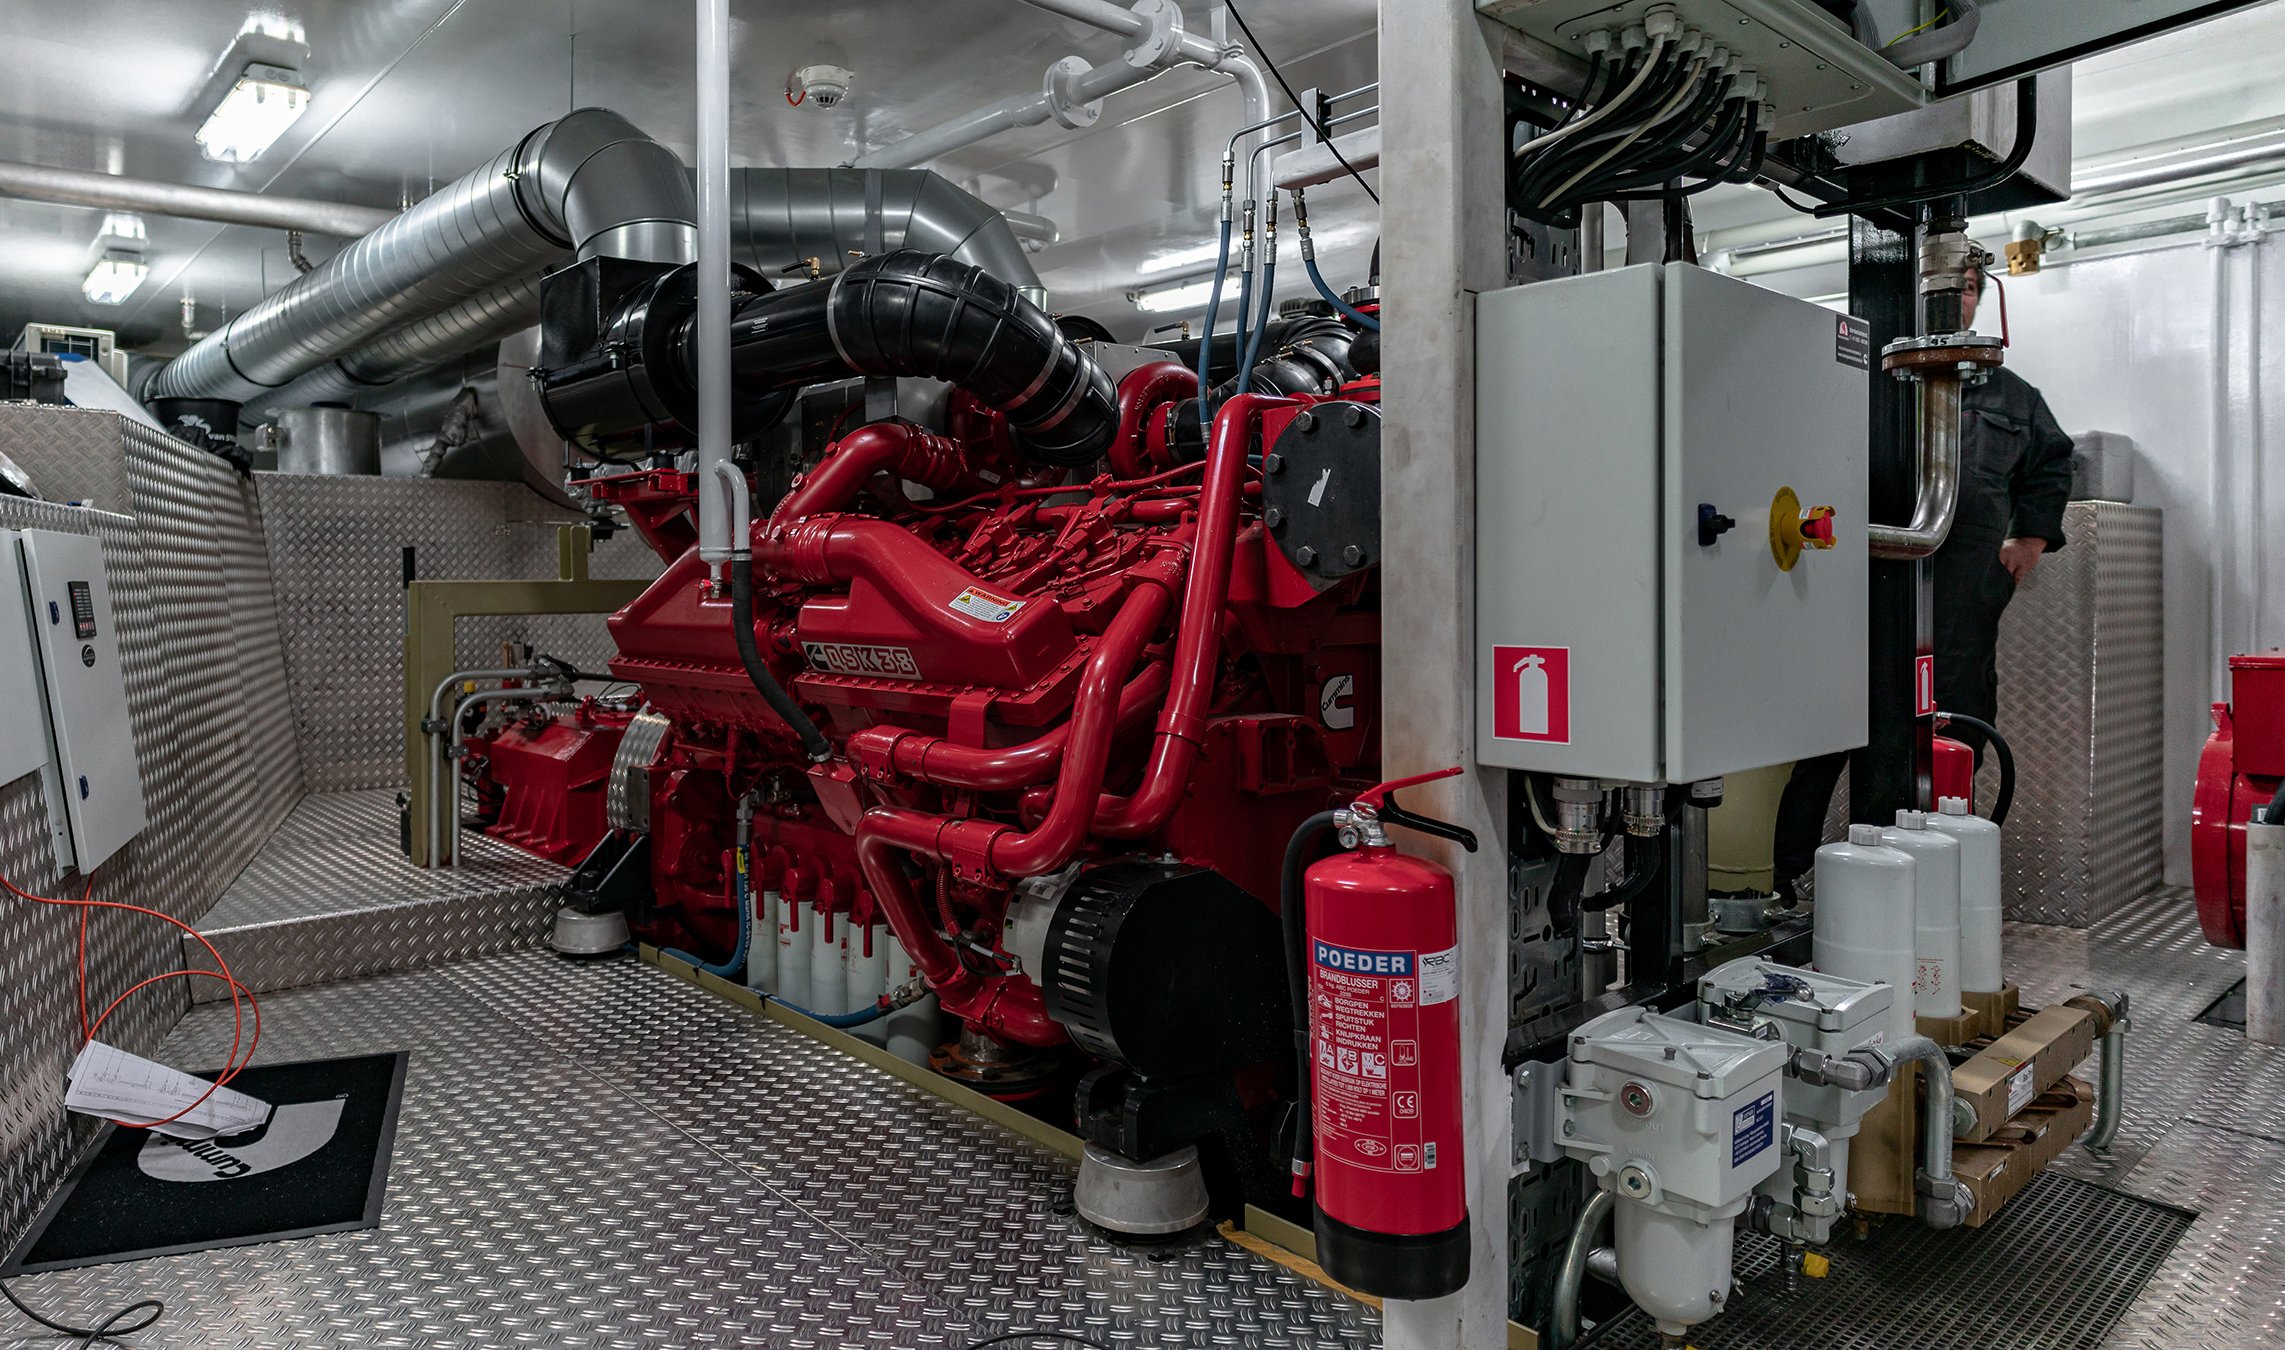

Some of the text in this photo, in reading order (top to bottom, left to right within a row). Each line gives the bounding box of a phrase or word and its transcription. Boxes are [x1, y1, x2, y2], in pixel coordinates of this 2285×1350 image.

[975, 589, 1009, 607] WARNING
[824, 645, 918, 676] QSK38
[1322, 674, 1351, 711] Cummins
[1318, 946, 1406, 973] POEDER
[1319, 969, 1379, 990] BRANDBLUSSER
[1347, 987, 1370, 995] POEDER
[1334, 997, 1369, 1009] BORGPEN
[1334, 1004, 1385, 1018] WEGTREKKEN
[1335, 1013, 1374, 1026] SPUITSTUK
[1335, 1020, 1366, 1033] RICHTEN
[1335, 1029, 1382, 1043] KNIJPKRAAN
[1336, 1037, 1378, 1050] INDRUKKEN
[1327, 1046, 1334, 1056] A
[1348, 1050, 1358, 1061] B
[1374, 1054, 1385, 1066] C
[159, 1132, 251, 1178] Cumm
